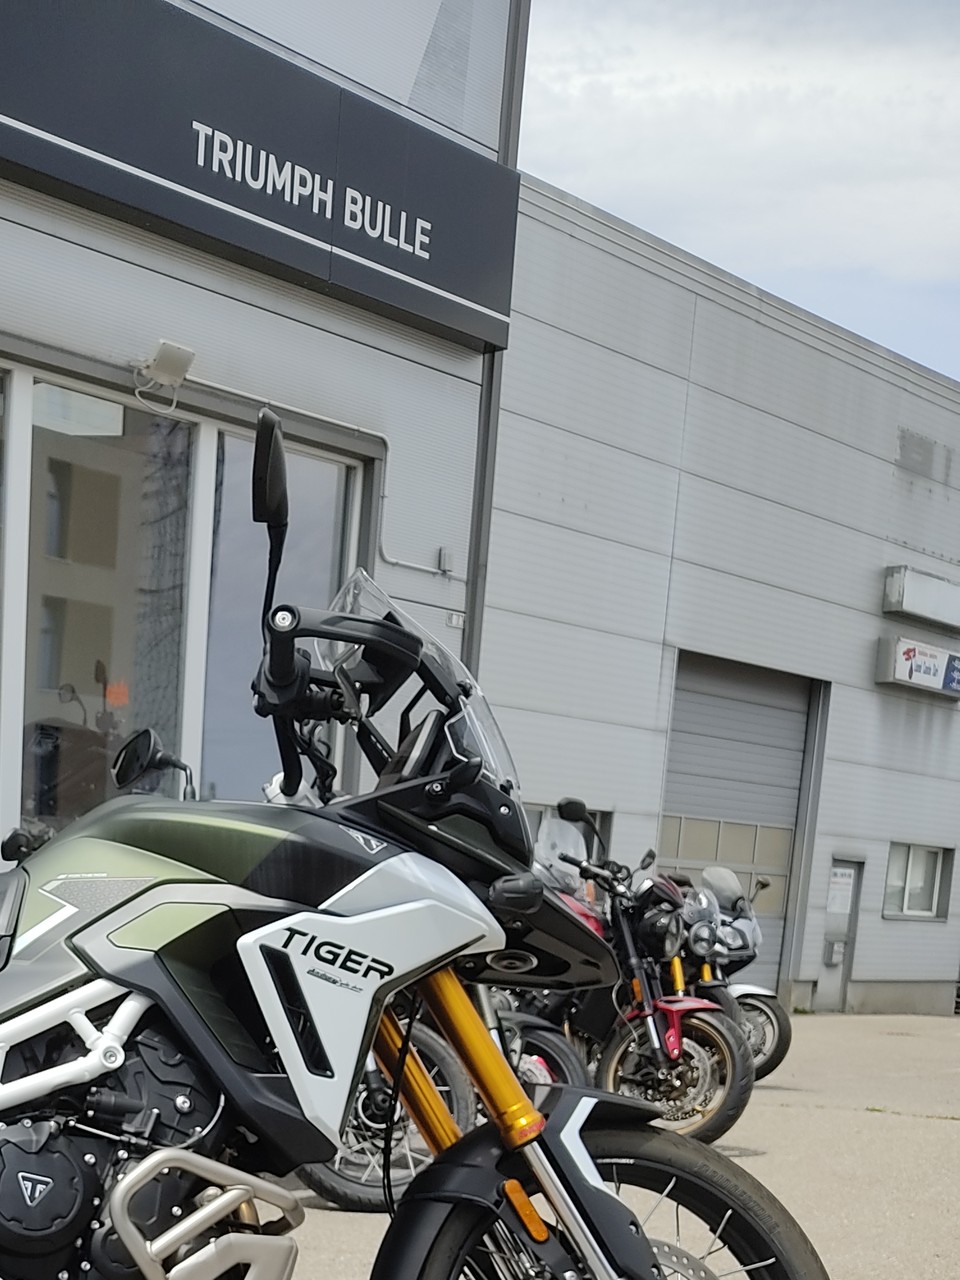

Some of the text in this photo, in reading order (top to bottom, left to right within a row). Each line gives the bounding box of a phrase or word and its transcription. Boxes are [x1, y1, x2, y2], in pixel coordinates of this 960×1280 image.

[192, 120, 432, 260] TRIUMPH BULLE
[282, 926, 395, 980] TIGER
